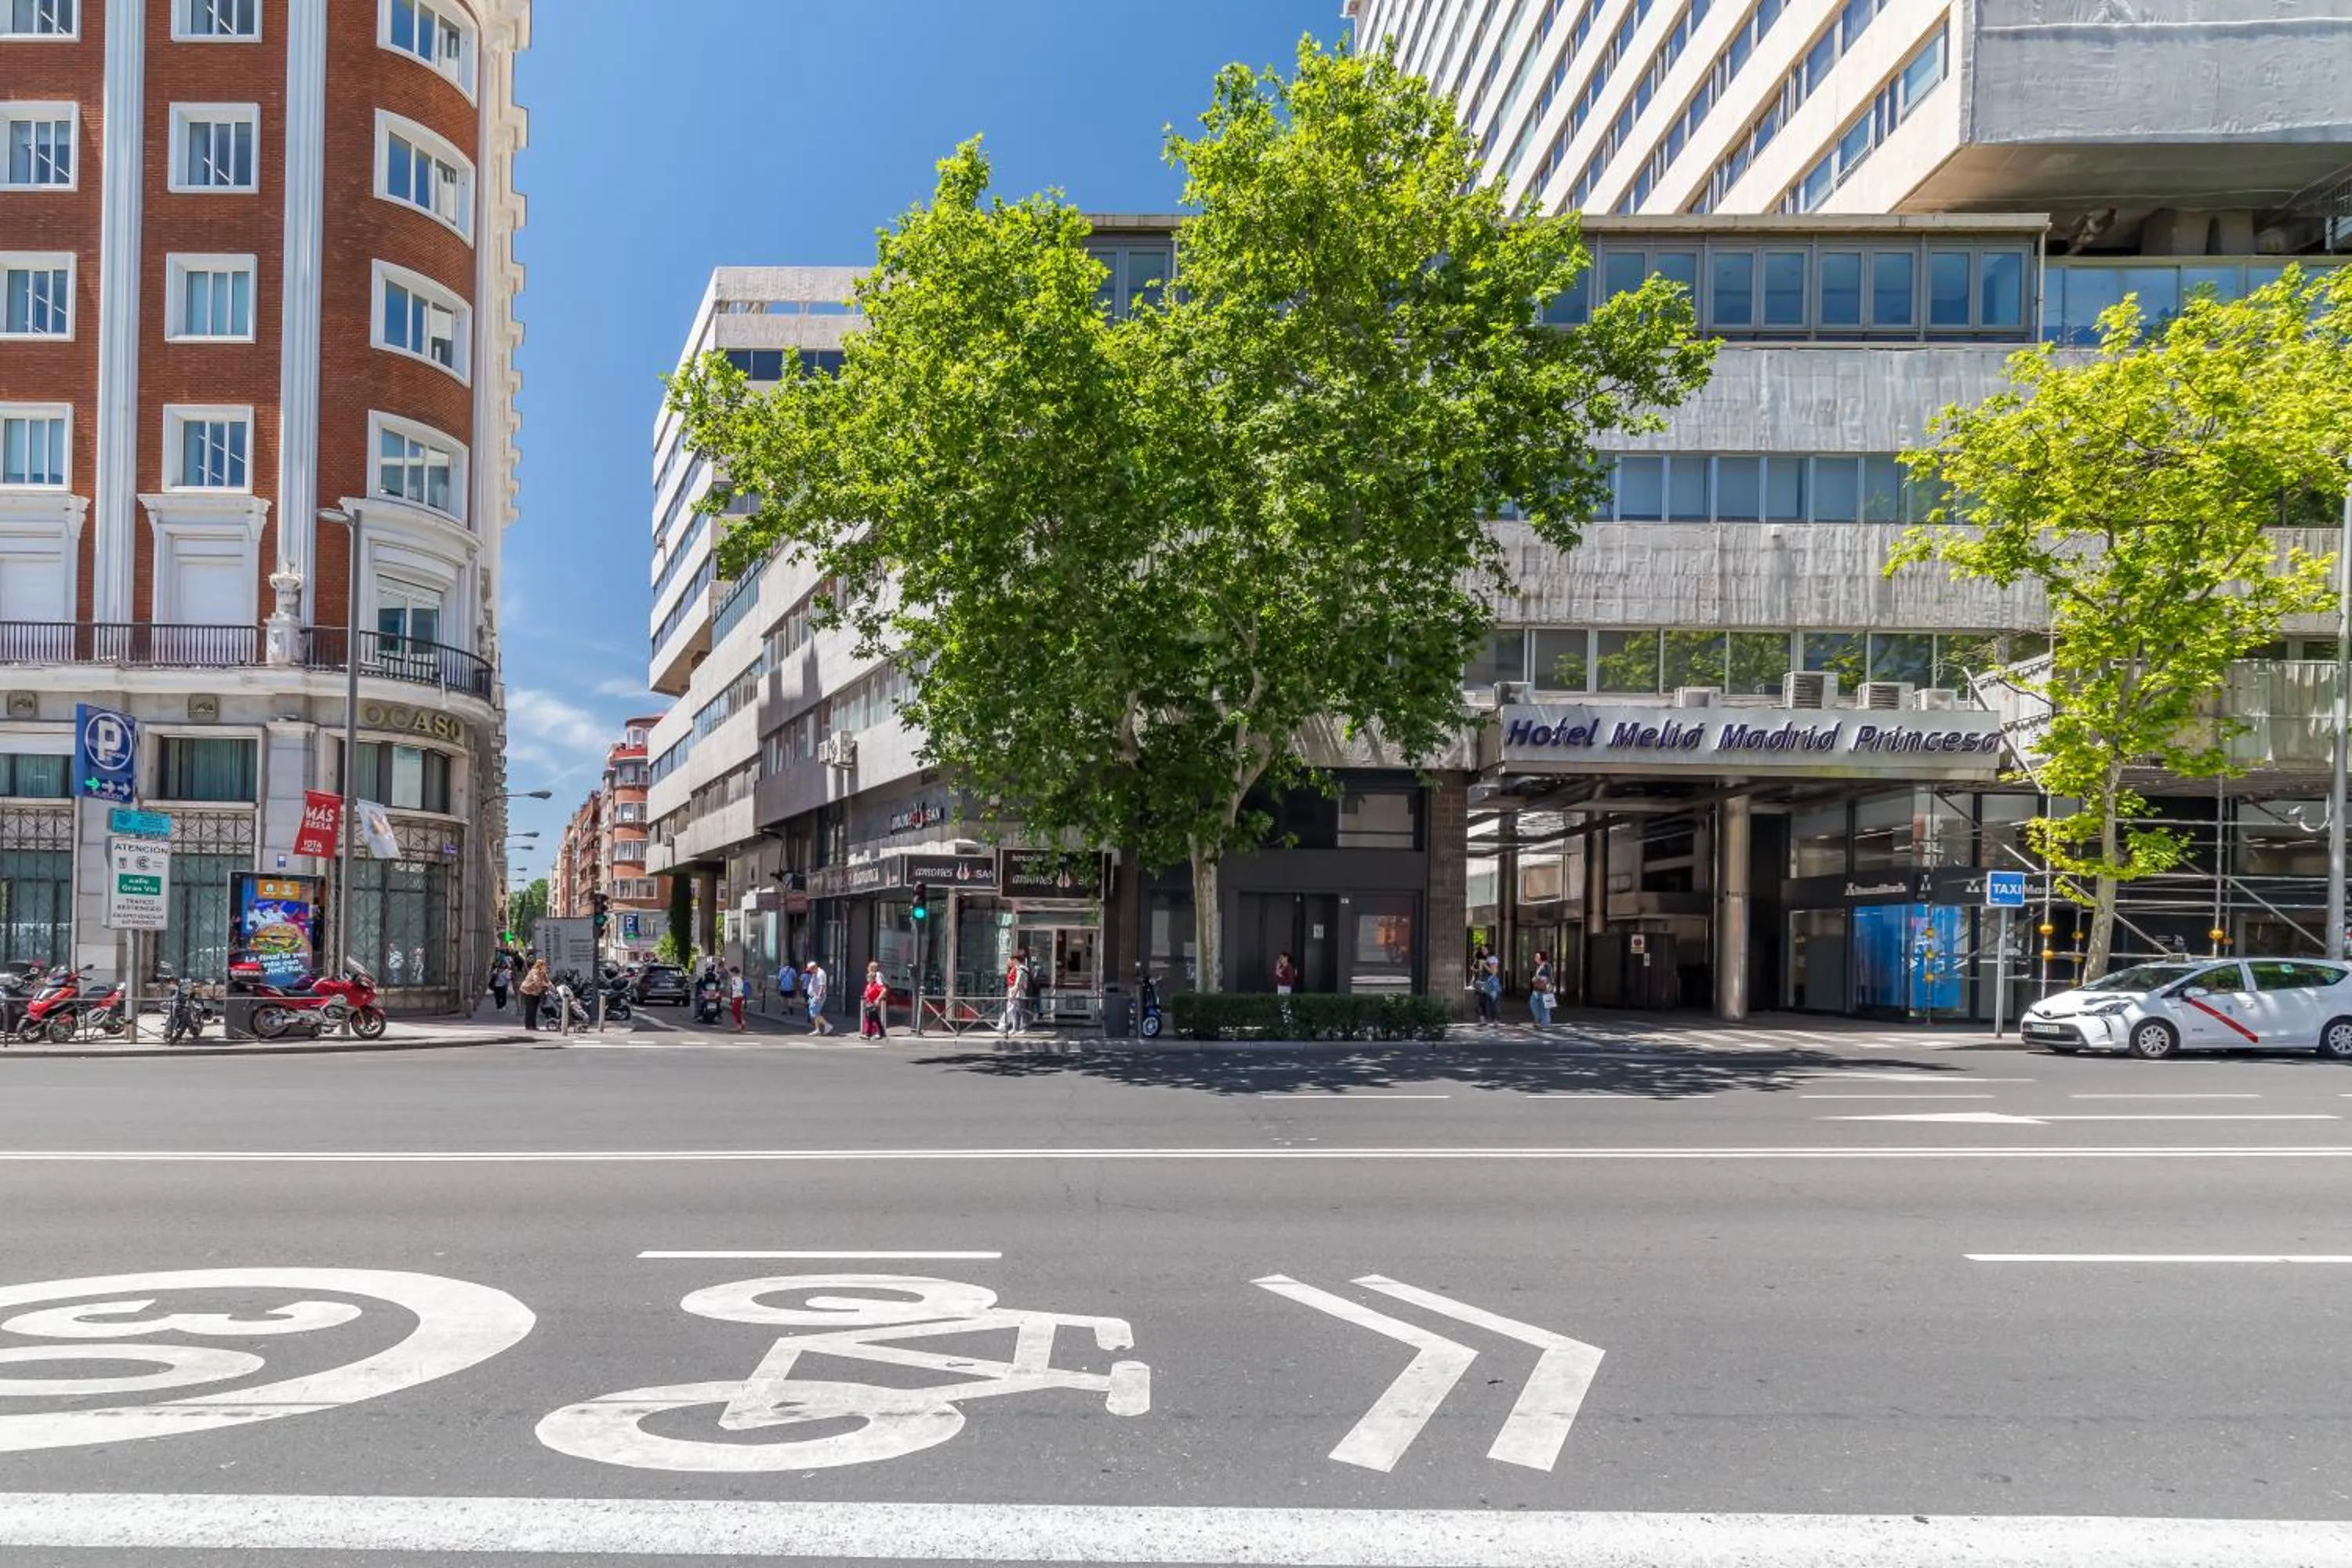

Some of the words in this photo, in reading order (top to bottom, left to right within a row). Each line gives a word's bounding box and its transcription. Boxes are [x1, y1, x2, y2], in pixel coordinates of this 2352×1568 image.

[363, 705, 464, 740] OCASO
[97, 719, 122, 761] P
[1506, 717, 1599, 748] Hotel
[1607, 720, 1705, 750] Meliá
[1715, 720, 1843, 753] Madrid
[1849, 724, 2005, 754] Princesa
[305, 804, 335, 823] MÁS
[122, 884, 143, 892] Gran
[1993, 884, 2022, 895] TAXI
[258, 953, 280, 962] final
